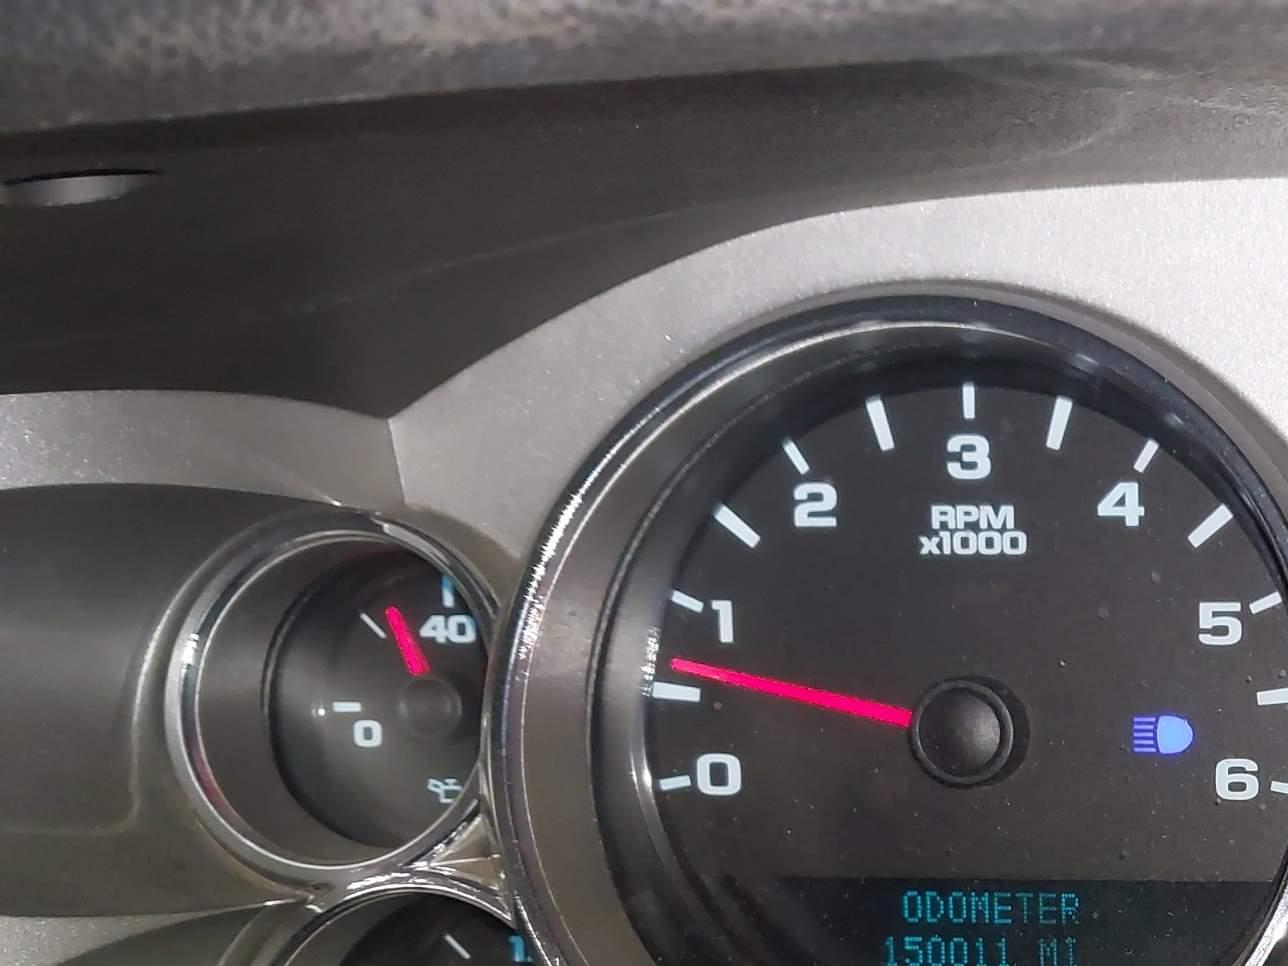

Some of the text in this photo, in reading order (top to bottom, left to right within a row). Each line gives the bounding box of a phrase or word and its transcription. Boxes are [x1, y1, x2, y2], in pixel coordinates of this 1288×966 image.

[946, 434, 992, 480] 3
[793, 482, 838, 527] 2
[931, 504, 1015, 530] RPM
[1097, 481, 1145, 527] 4
[919, 529, 1027, 555] x1000
[419, 614, 476, 644] 40
[711, 599, 734, 643] 1
[1198, 601, 1242, 646] 5
[353, 719, 383, 748] 0
[696, 753, 742, 796] 0
[1215, 758, 1260, 802] 6
[902, 889, 1080, 925] ODOMETER
